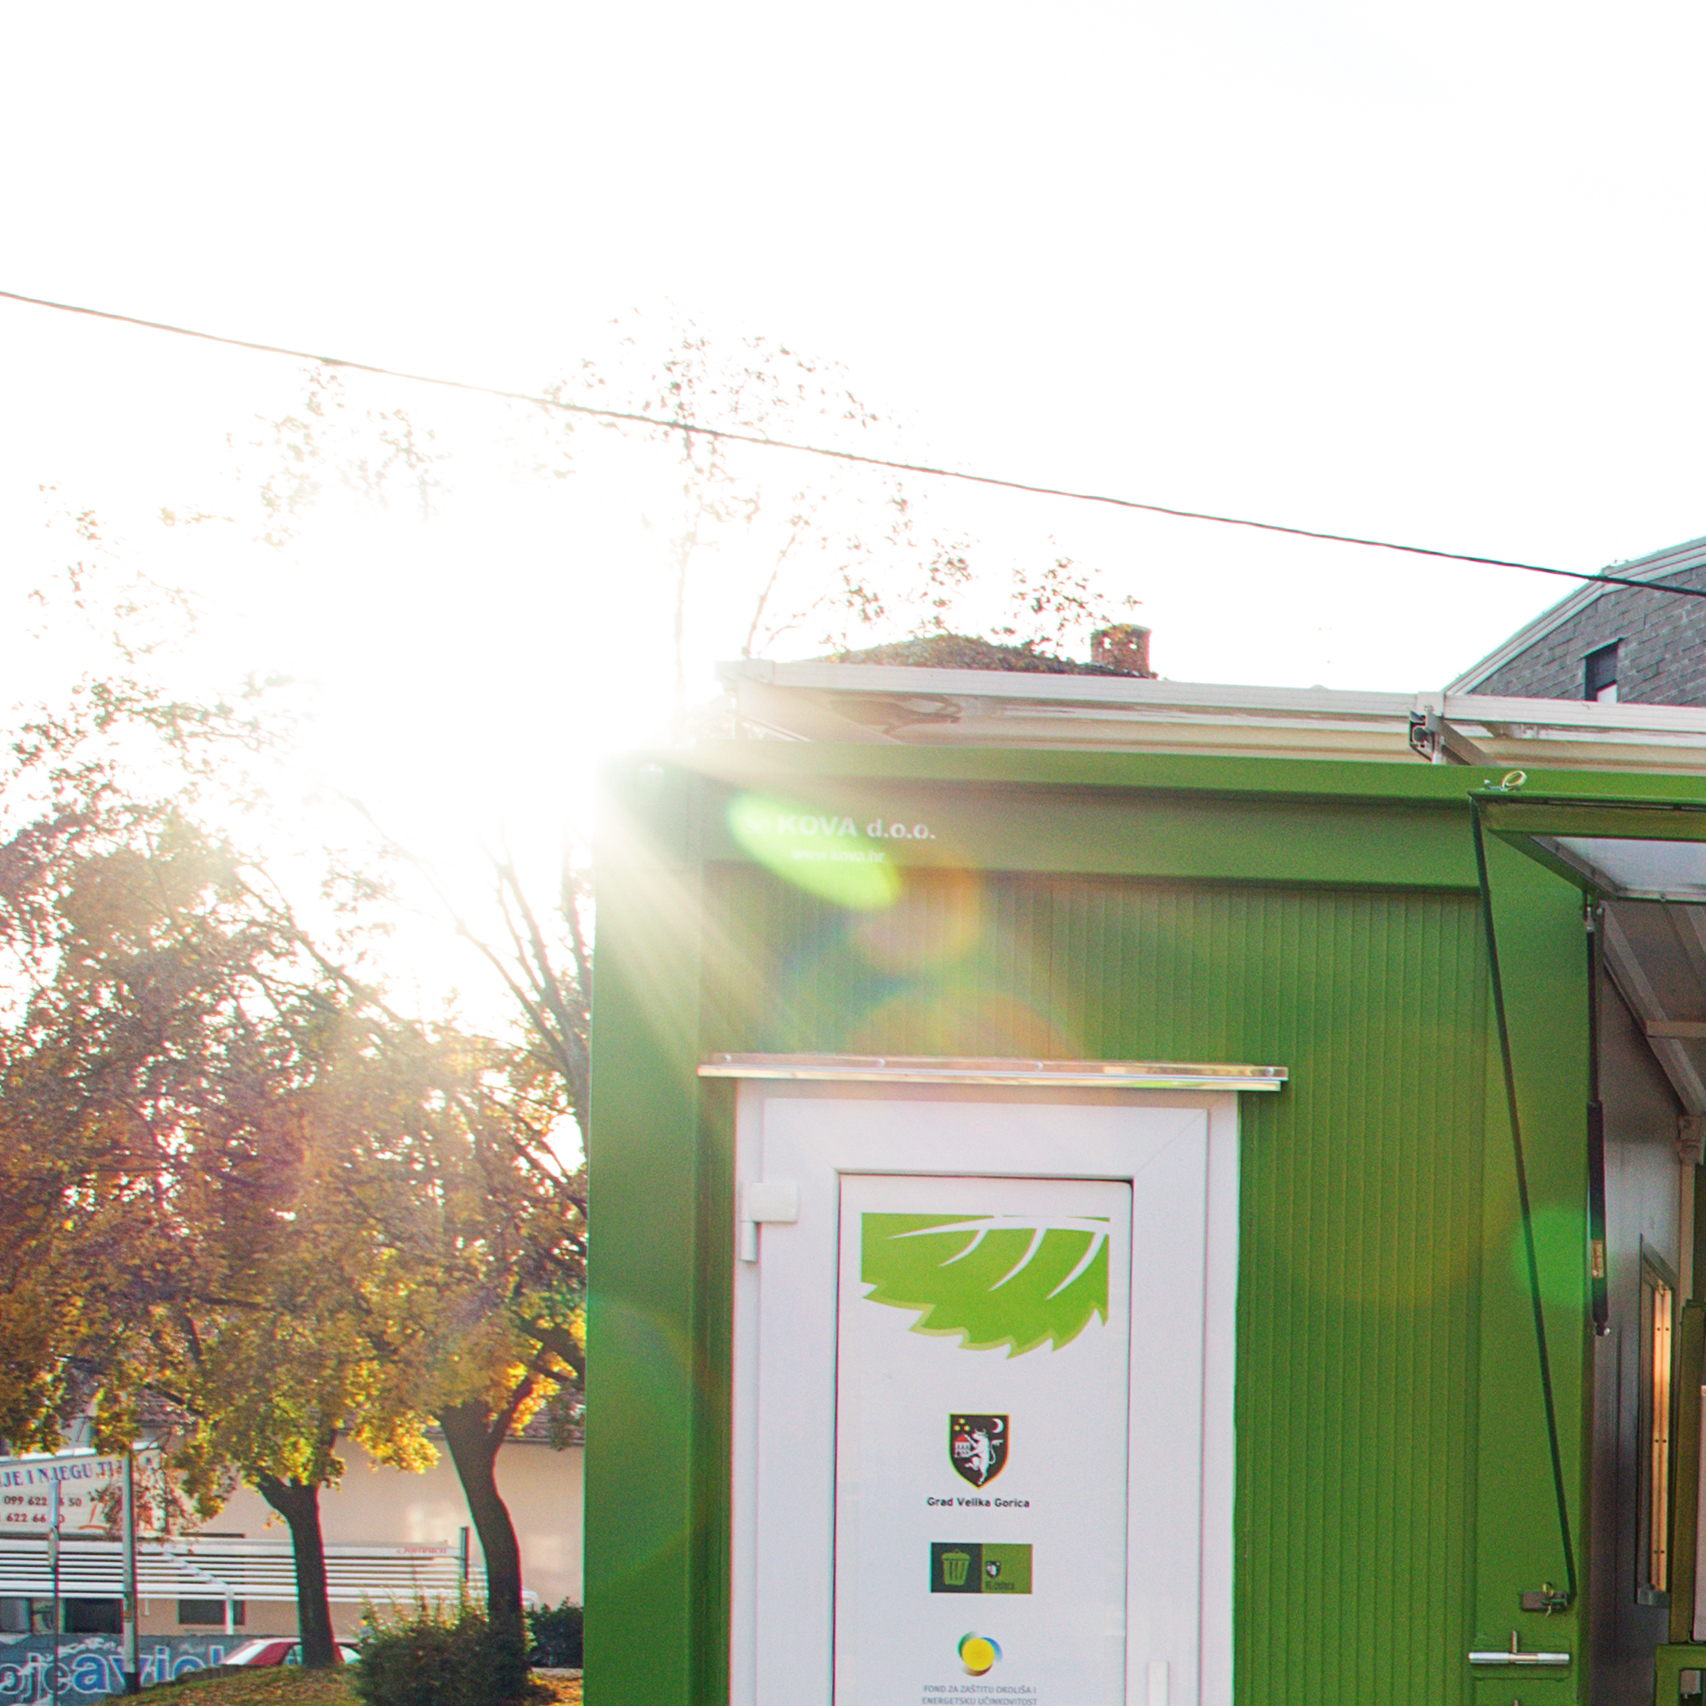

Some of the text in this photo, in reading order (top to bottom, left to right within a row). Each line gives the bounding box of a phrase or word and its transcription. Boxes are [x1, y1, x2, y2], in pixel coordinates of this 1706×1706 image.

[777, 815, 936, 840] KOVA d.o.o.
[27, 1495, 48, 1506] 622
[68, 1497, 82, 1507] 50
[927, 1496, 1031, 1509] Grad Velika Gorica
[6, 1512, 28, 1523] 622
[923, 1684, 946, 1694] FOND
